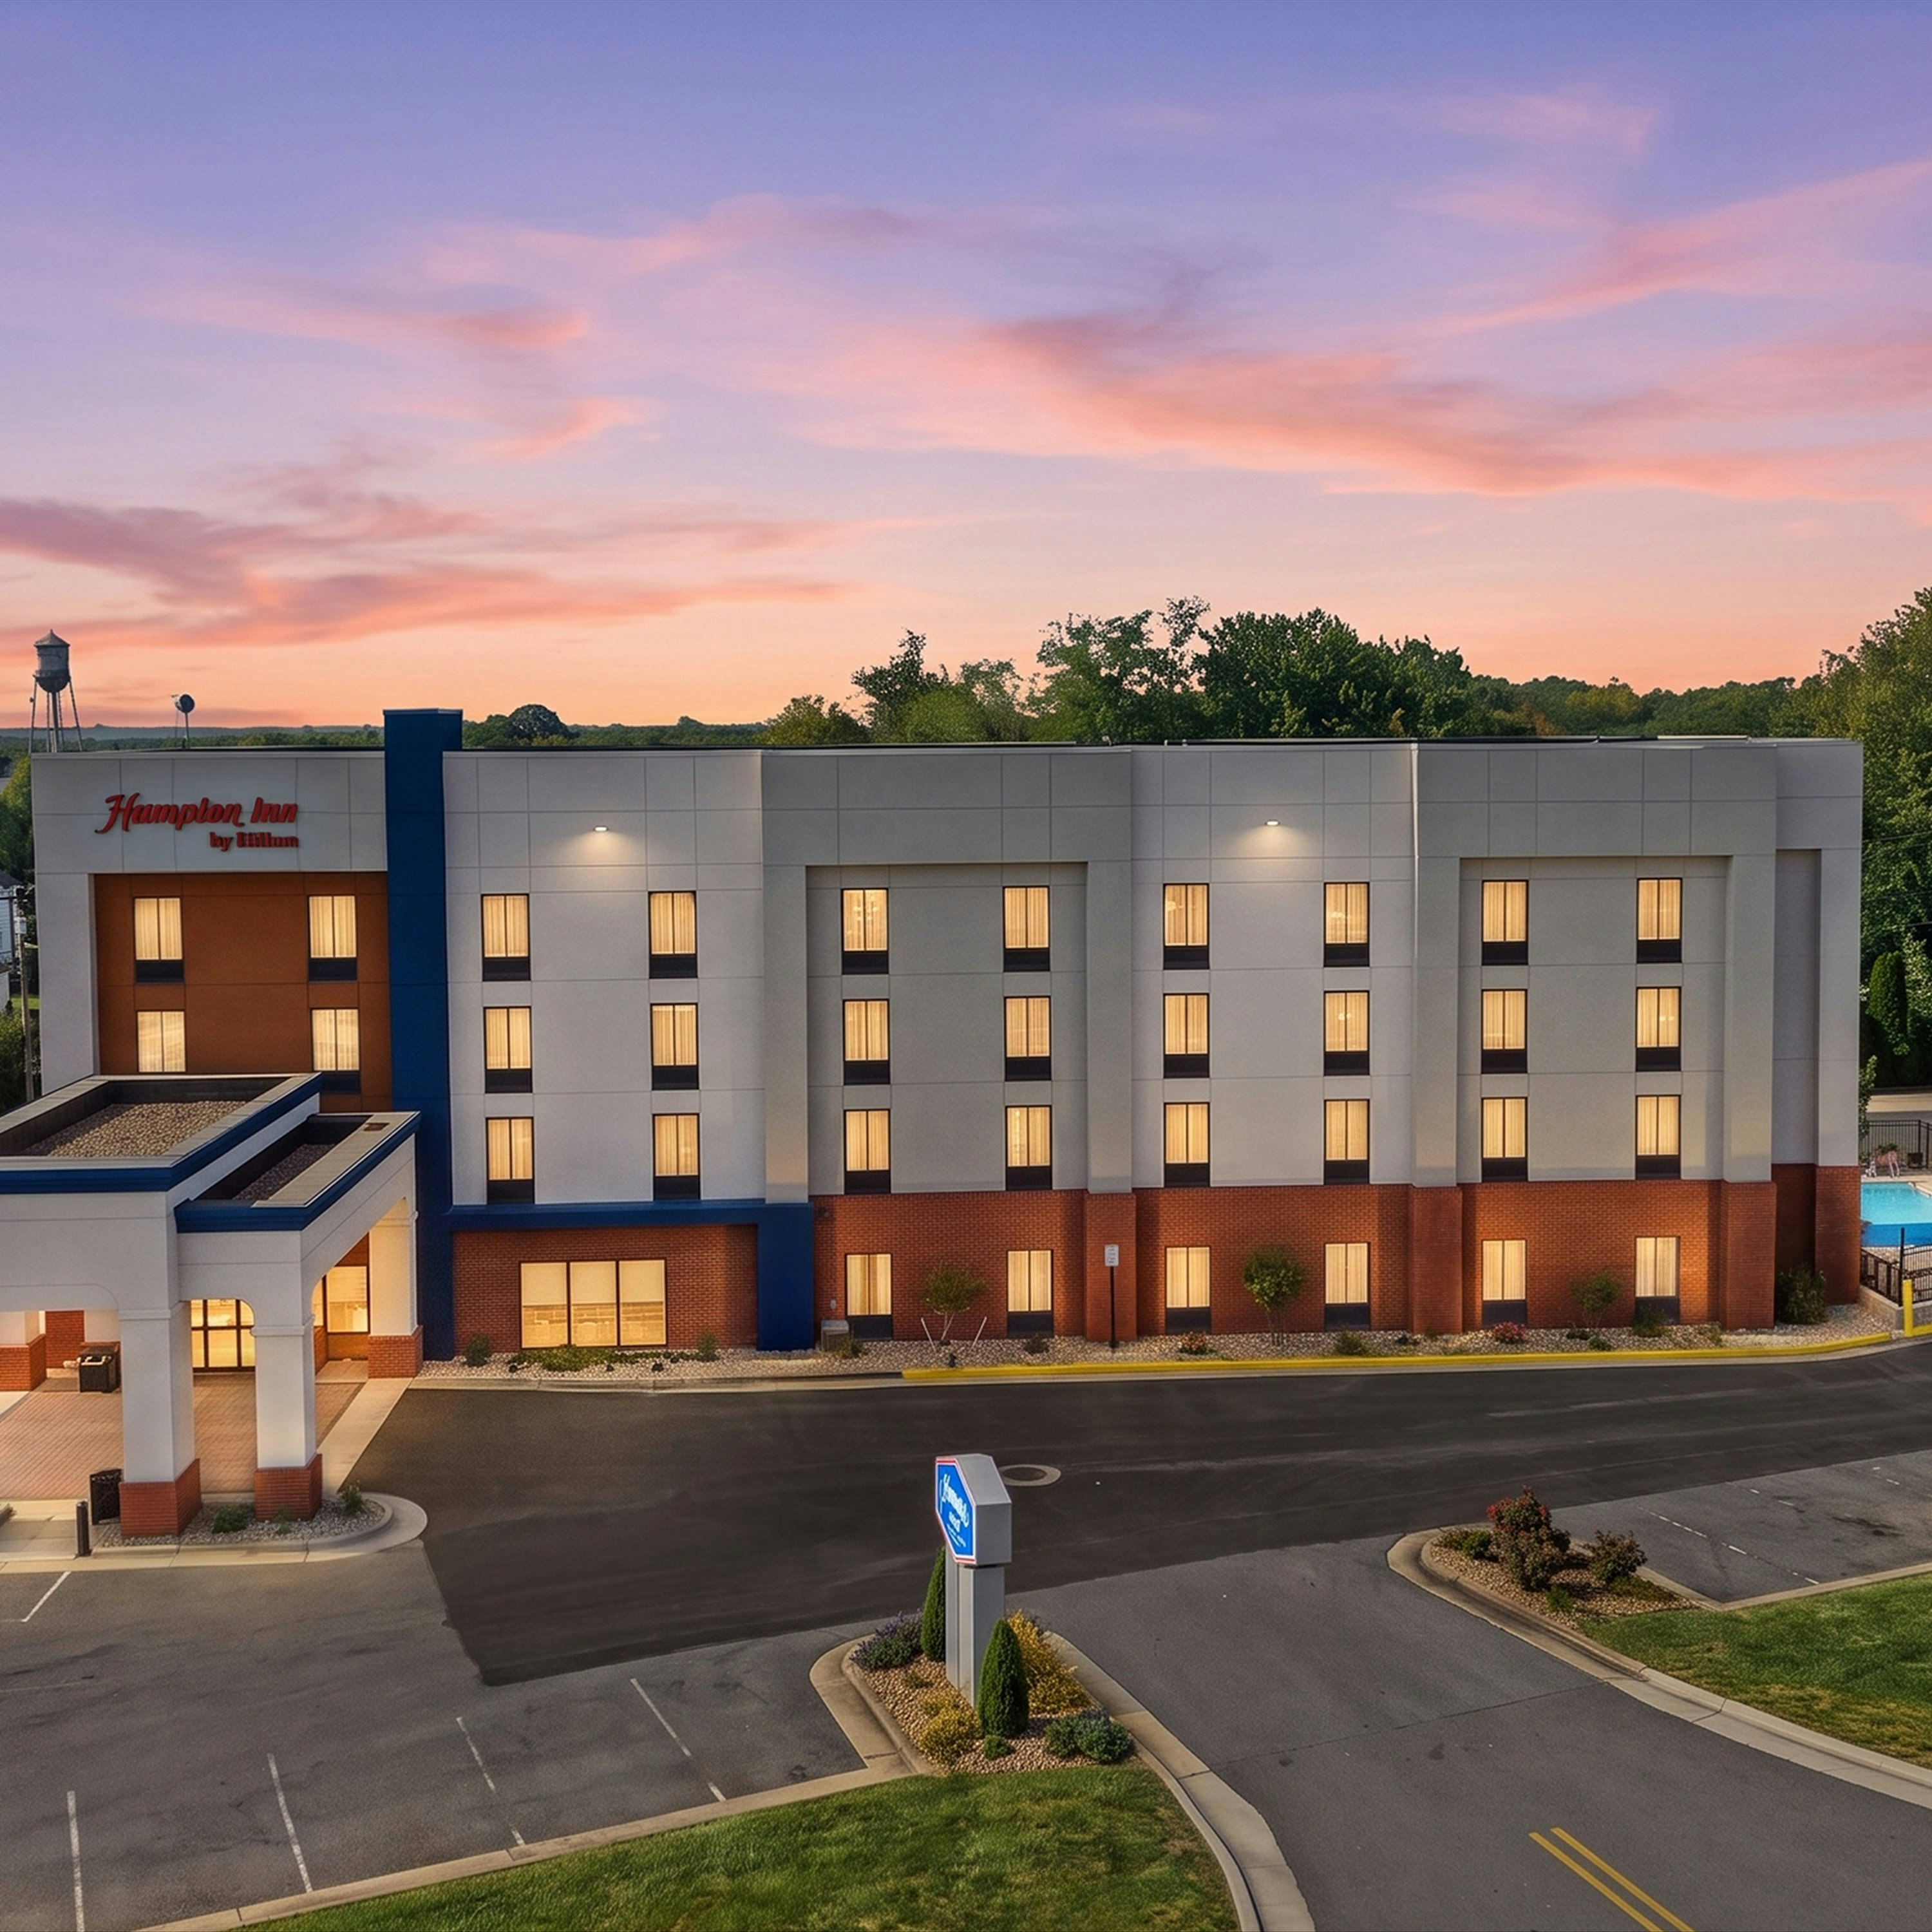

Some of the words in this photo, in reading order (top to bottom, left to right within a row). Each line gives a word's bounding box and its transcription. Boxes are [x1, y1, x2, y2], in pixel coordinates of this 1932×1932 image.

[95, 793, 245, 834] Hampton
[251, 797, 298, 823] Inn
[209, 831, 233, 851] by
